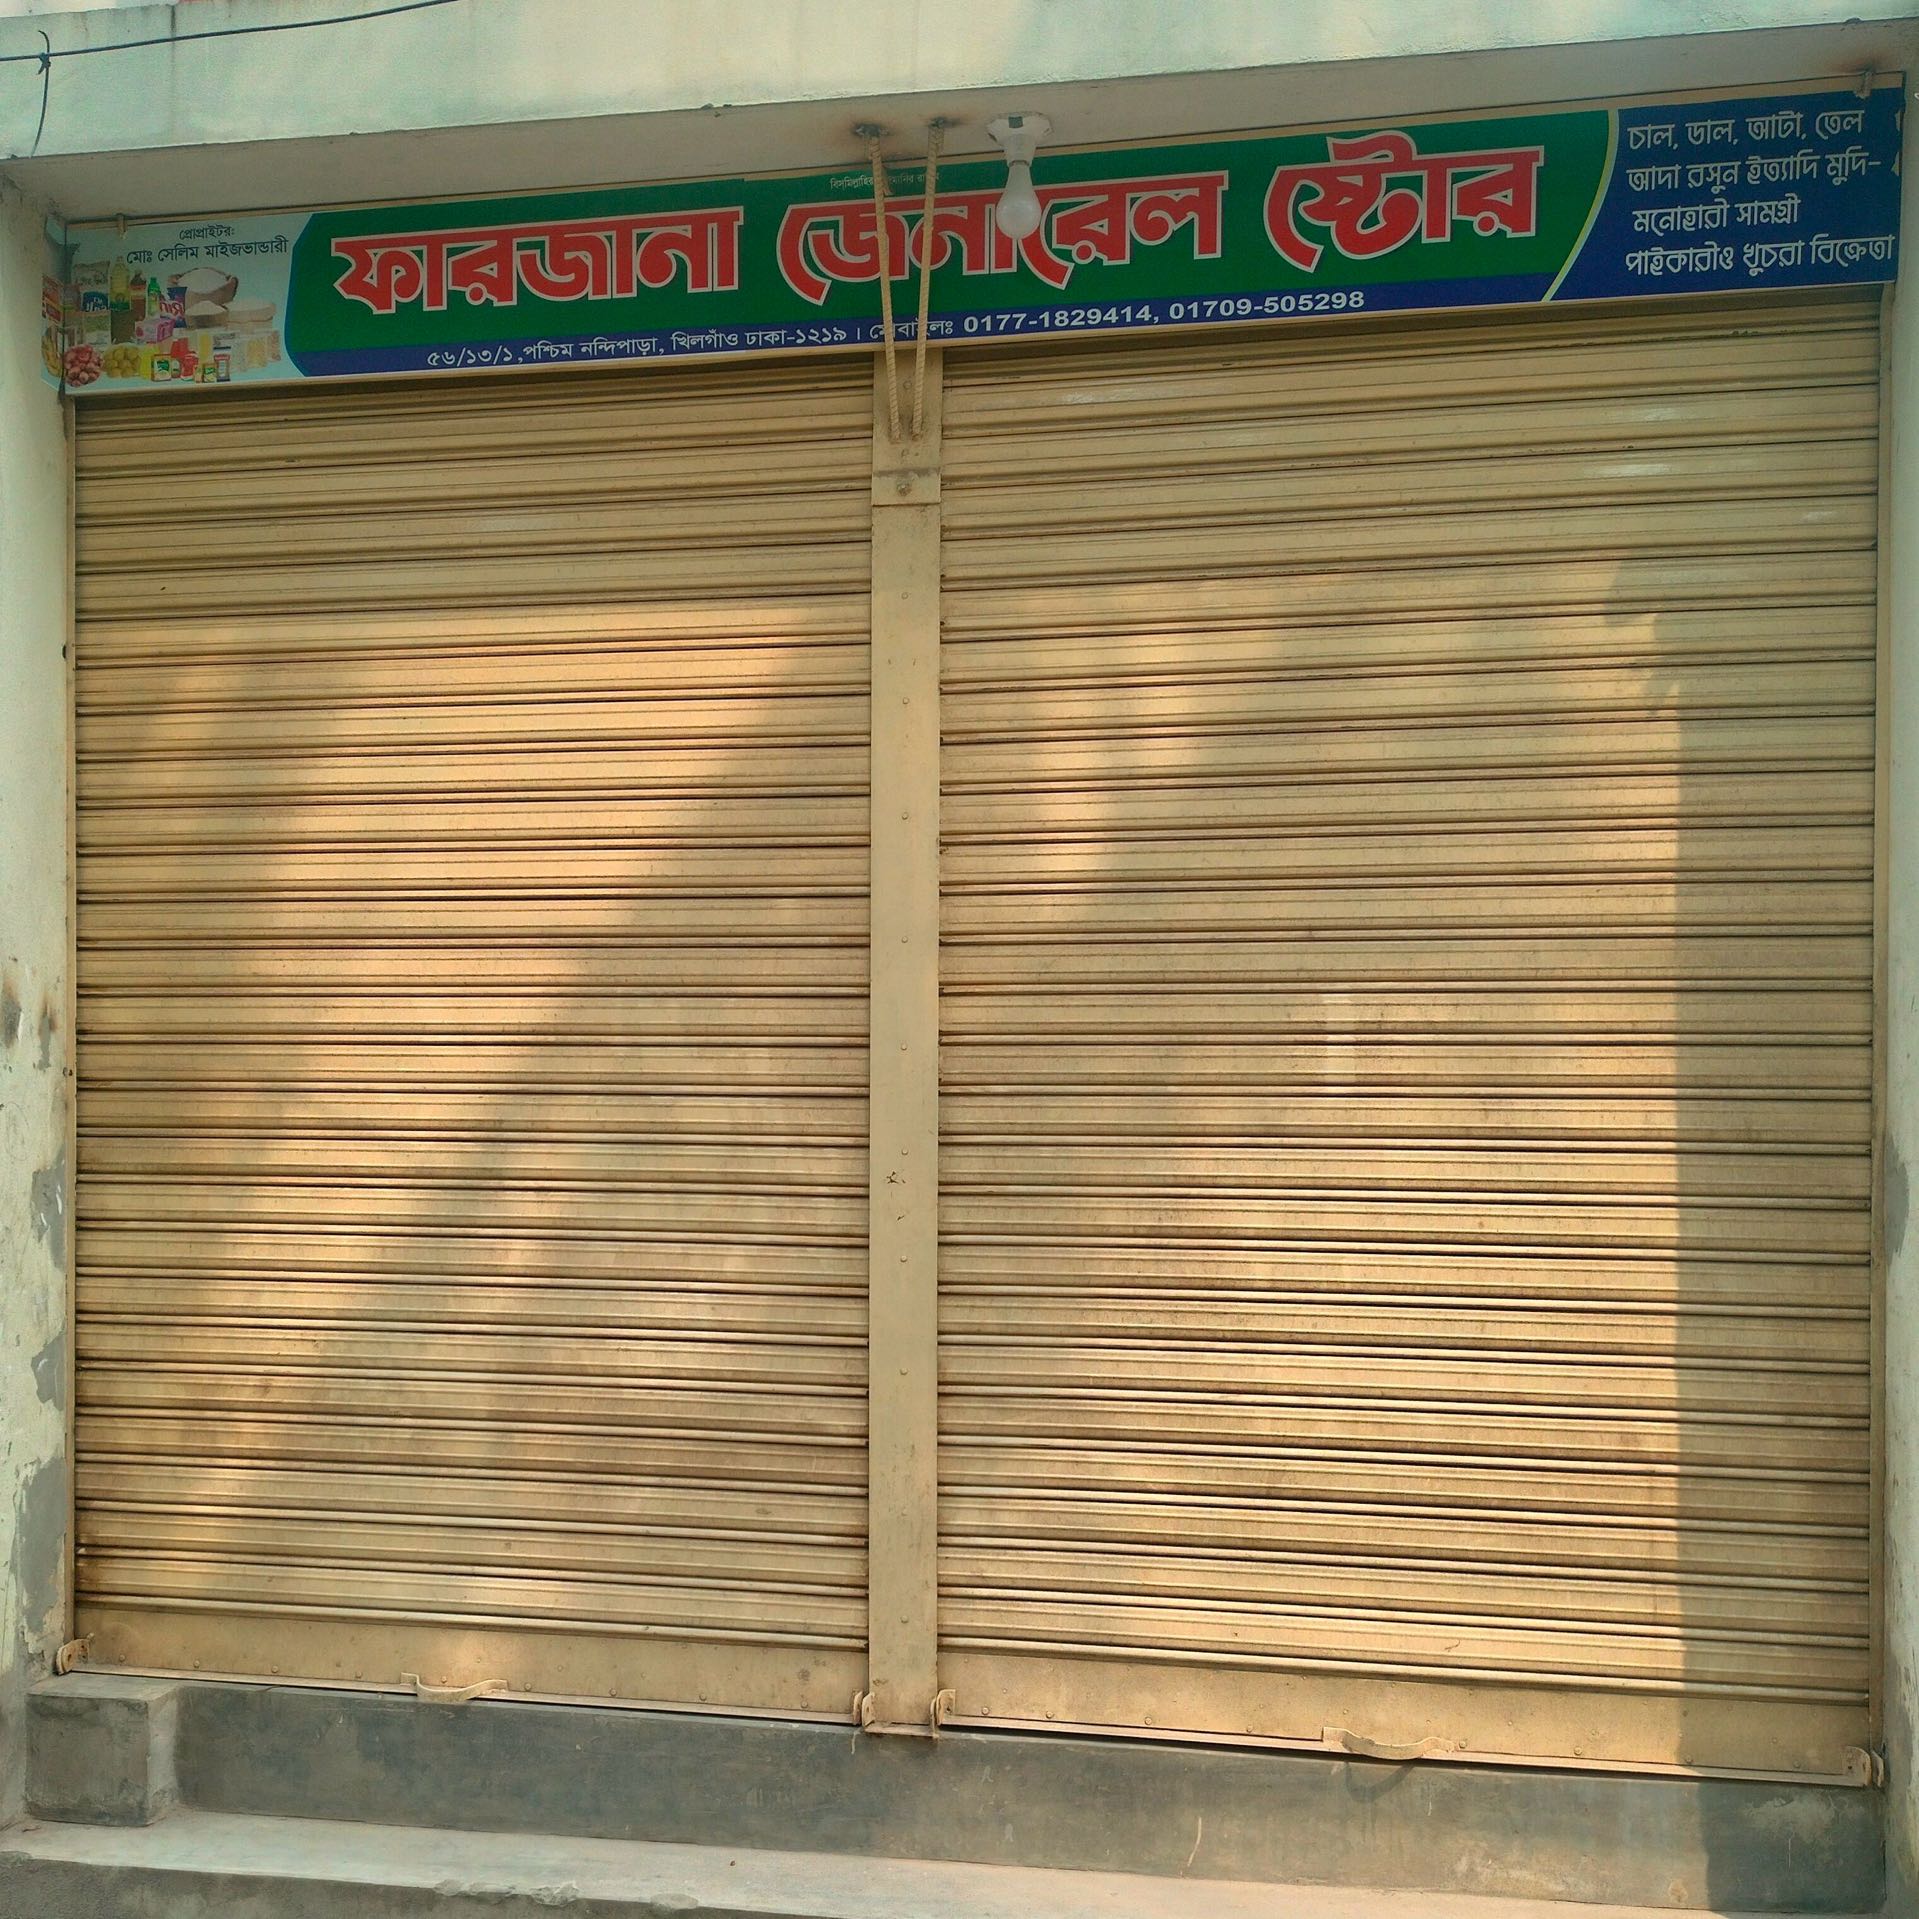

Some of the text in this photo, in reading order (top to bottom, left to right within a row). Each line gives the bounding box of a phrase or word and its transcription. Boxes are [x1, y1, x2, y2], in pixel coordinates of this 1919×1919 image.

[1627, 109, 1865, 150] চাল, ডাল, আটা, তেল
[1626, 163, 1682, 192] আদা
[1686, 160, 1741, 195] রসুন
[1745, 148, 1821, 185] ইত্যাদি
[331, 129, 1545, 315] ফারজানা জেনারেল ষ্টোর
[1632, 192, 1802, 238] মনোহারী সামগ্রী
[157, 244, 199, 263] সেলিম
[1624, 233, 1896, 277] পাইকারীও খুচরা বিক্রেতা
[670, 328, 739, 351] খিলগাঁও
[963, 303, 1160, 334] 0177-1829414,
[1168, 290, 1365, 322] 01709-505298
